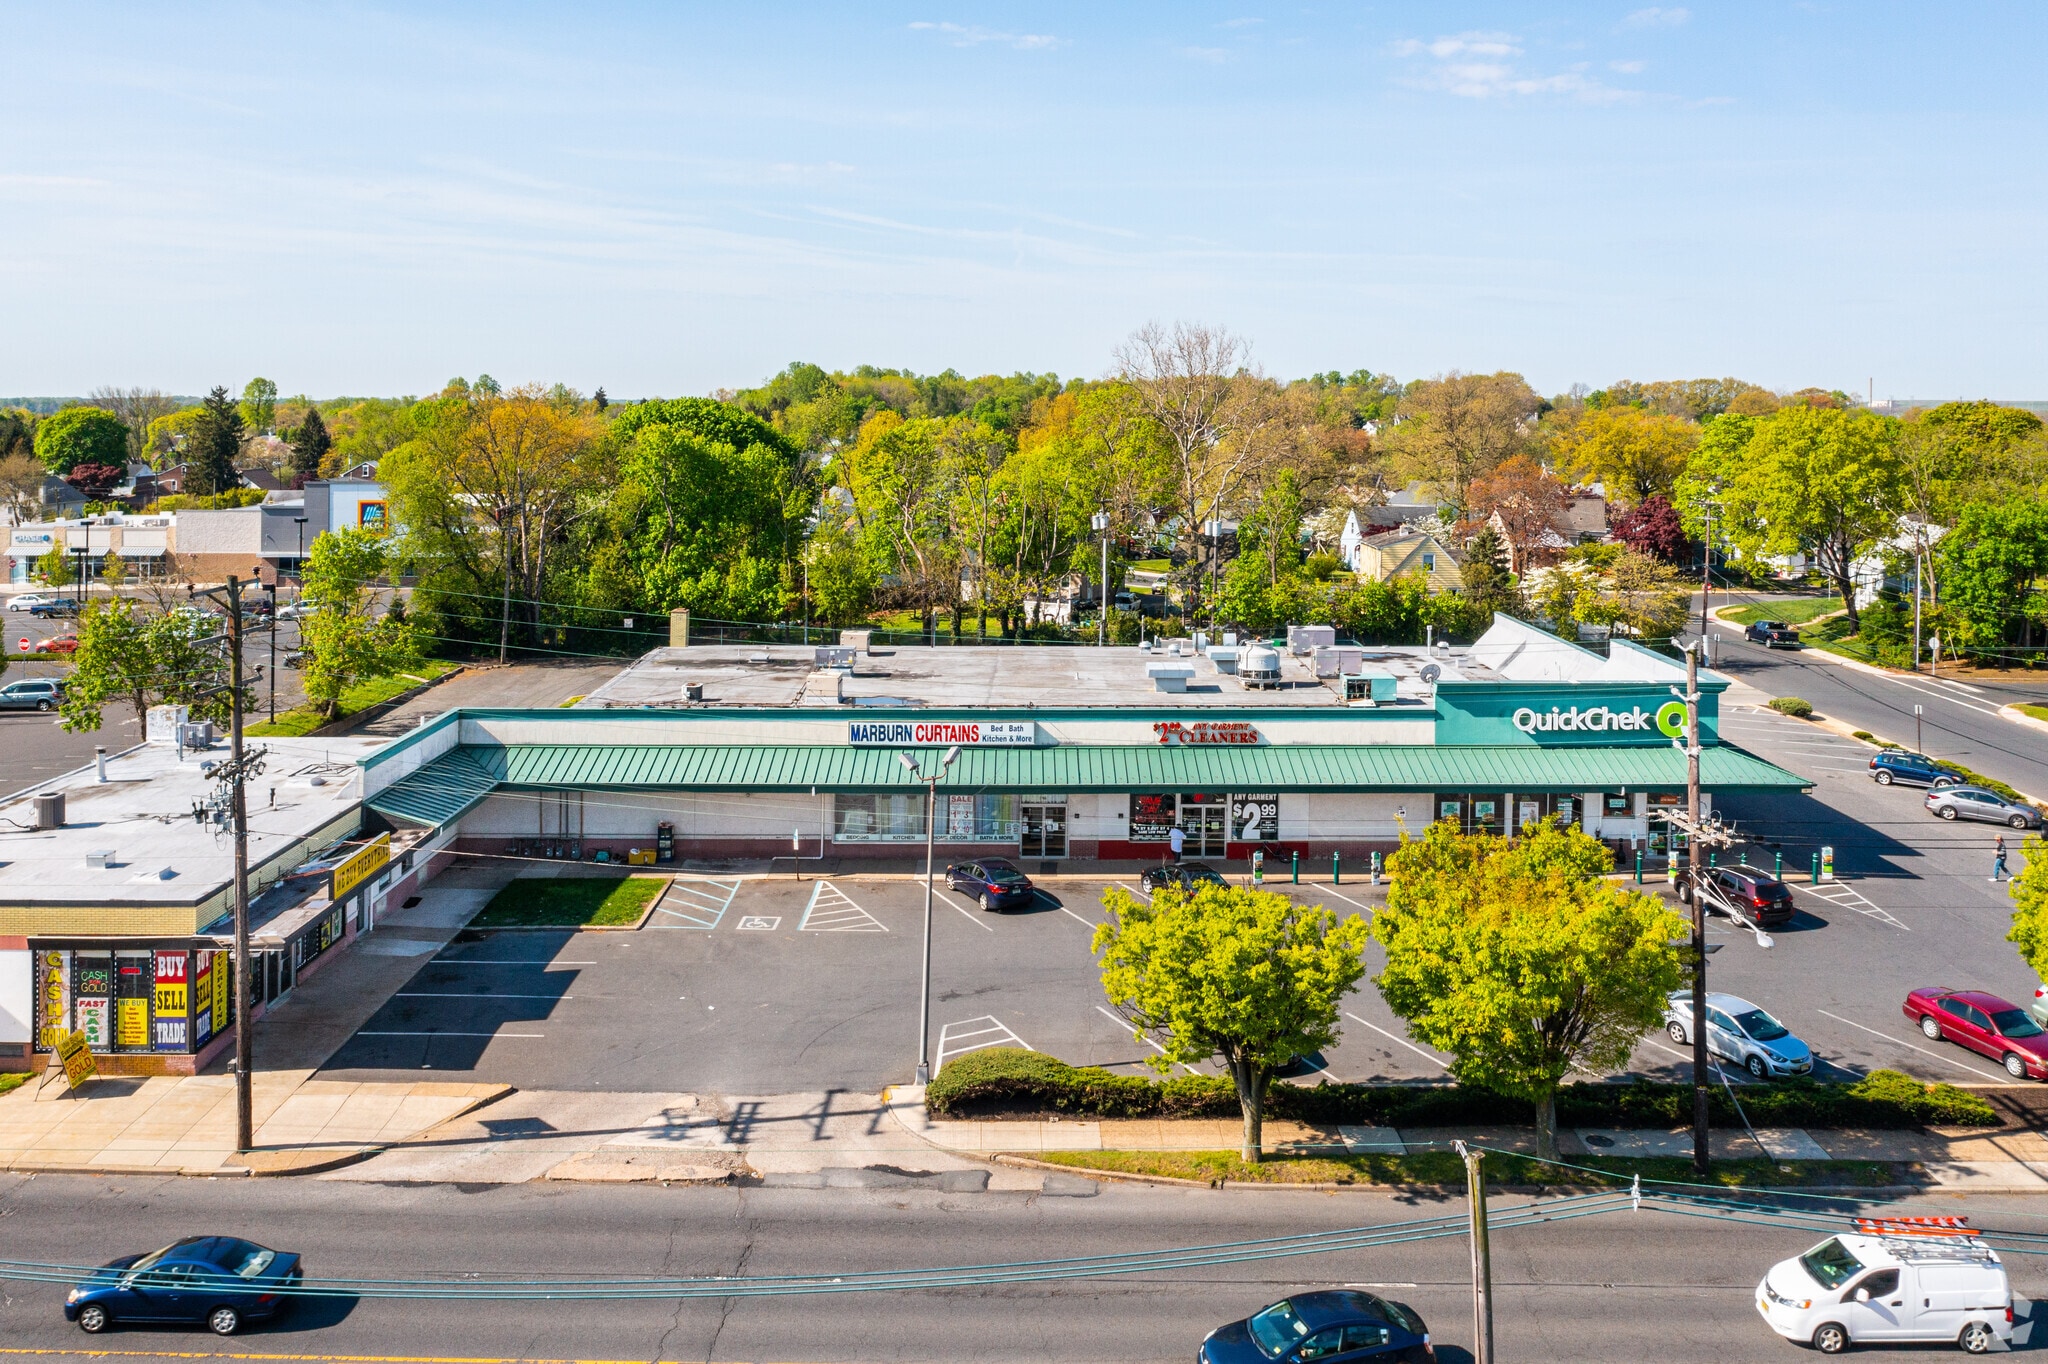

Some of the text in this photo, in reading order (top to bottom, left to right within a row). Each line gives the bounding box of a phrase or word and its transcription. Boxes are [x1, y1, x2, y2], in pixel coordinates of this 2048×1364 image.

[1512, 706, 1651, 734] QuickChek
[851, 724, 980, 742] MARBURN CURTAINS
[982, 735, 1008, 743] Kitchen
[1016, 735, 1033, 743] More
[1179, 730, 1258, 743] CLEANERS
[951, 795, 973, 803] SALE
[1233, 793, 1247, 801] ANY
[1247, 793, 1277, 801] GARMENT
[157, 956, 185, 977] BUY
[196, 951, 210, 974] BUY
[81, 970, 108, 981] CASH
[81, 982, 107, 993] GOLD
[196, 980, 210, 1006] SELL
[216, 953, 224, 1027] EVERYTHING
[157, 990, 186, 1011] SELL
[156, 1022, 186, 1044] TRADE
[65, 1048, 90, 1070] CASH FOR
[69, 1057, 92, 1078] GOLD
